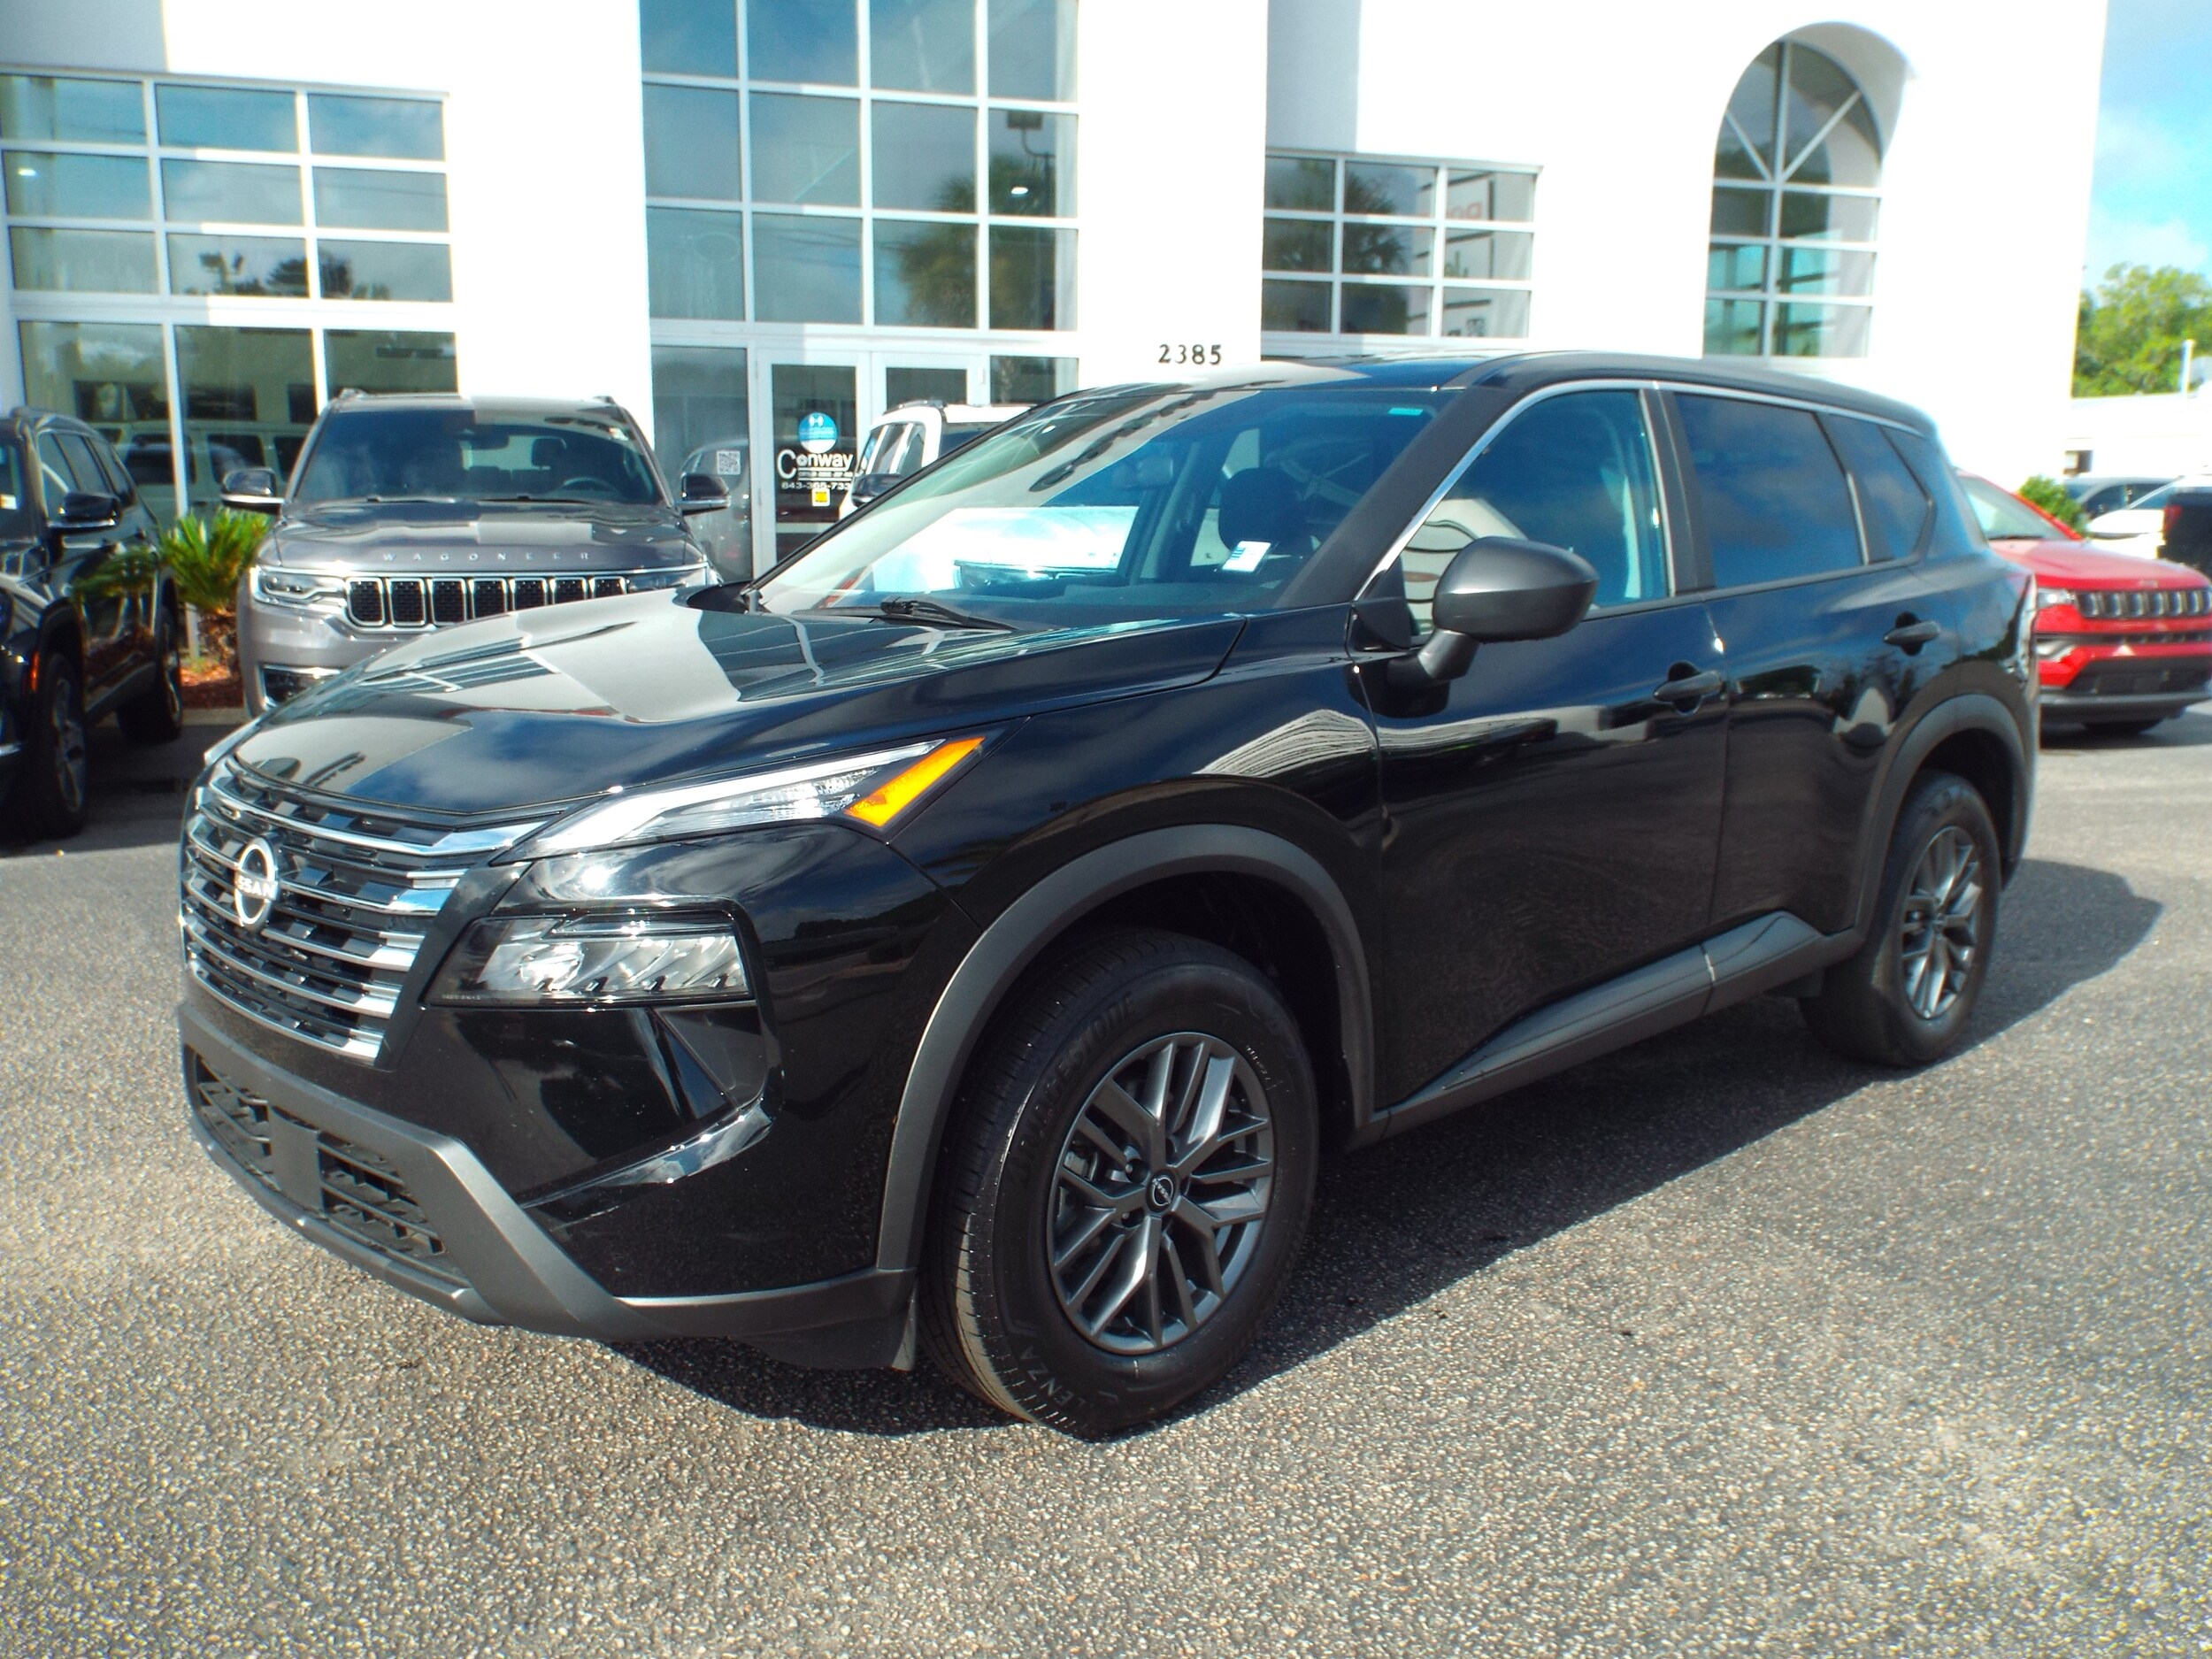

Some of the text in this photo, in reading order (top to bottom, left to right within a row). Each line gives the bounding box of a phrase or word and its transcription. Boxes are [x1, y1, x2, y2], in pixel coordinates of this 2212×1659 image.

[1158, 343, 1222, 365] 2385
[777, 449, 854, 479] Conway
[382, 552, 590, 562] WAGONEER
